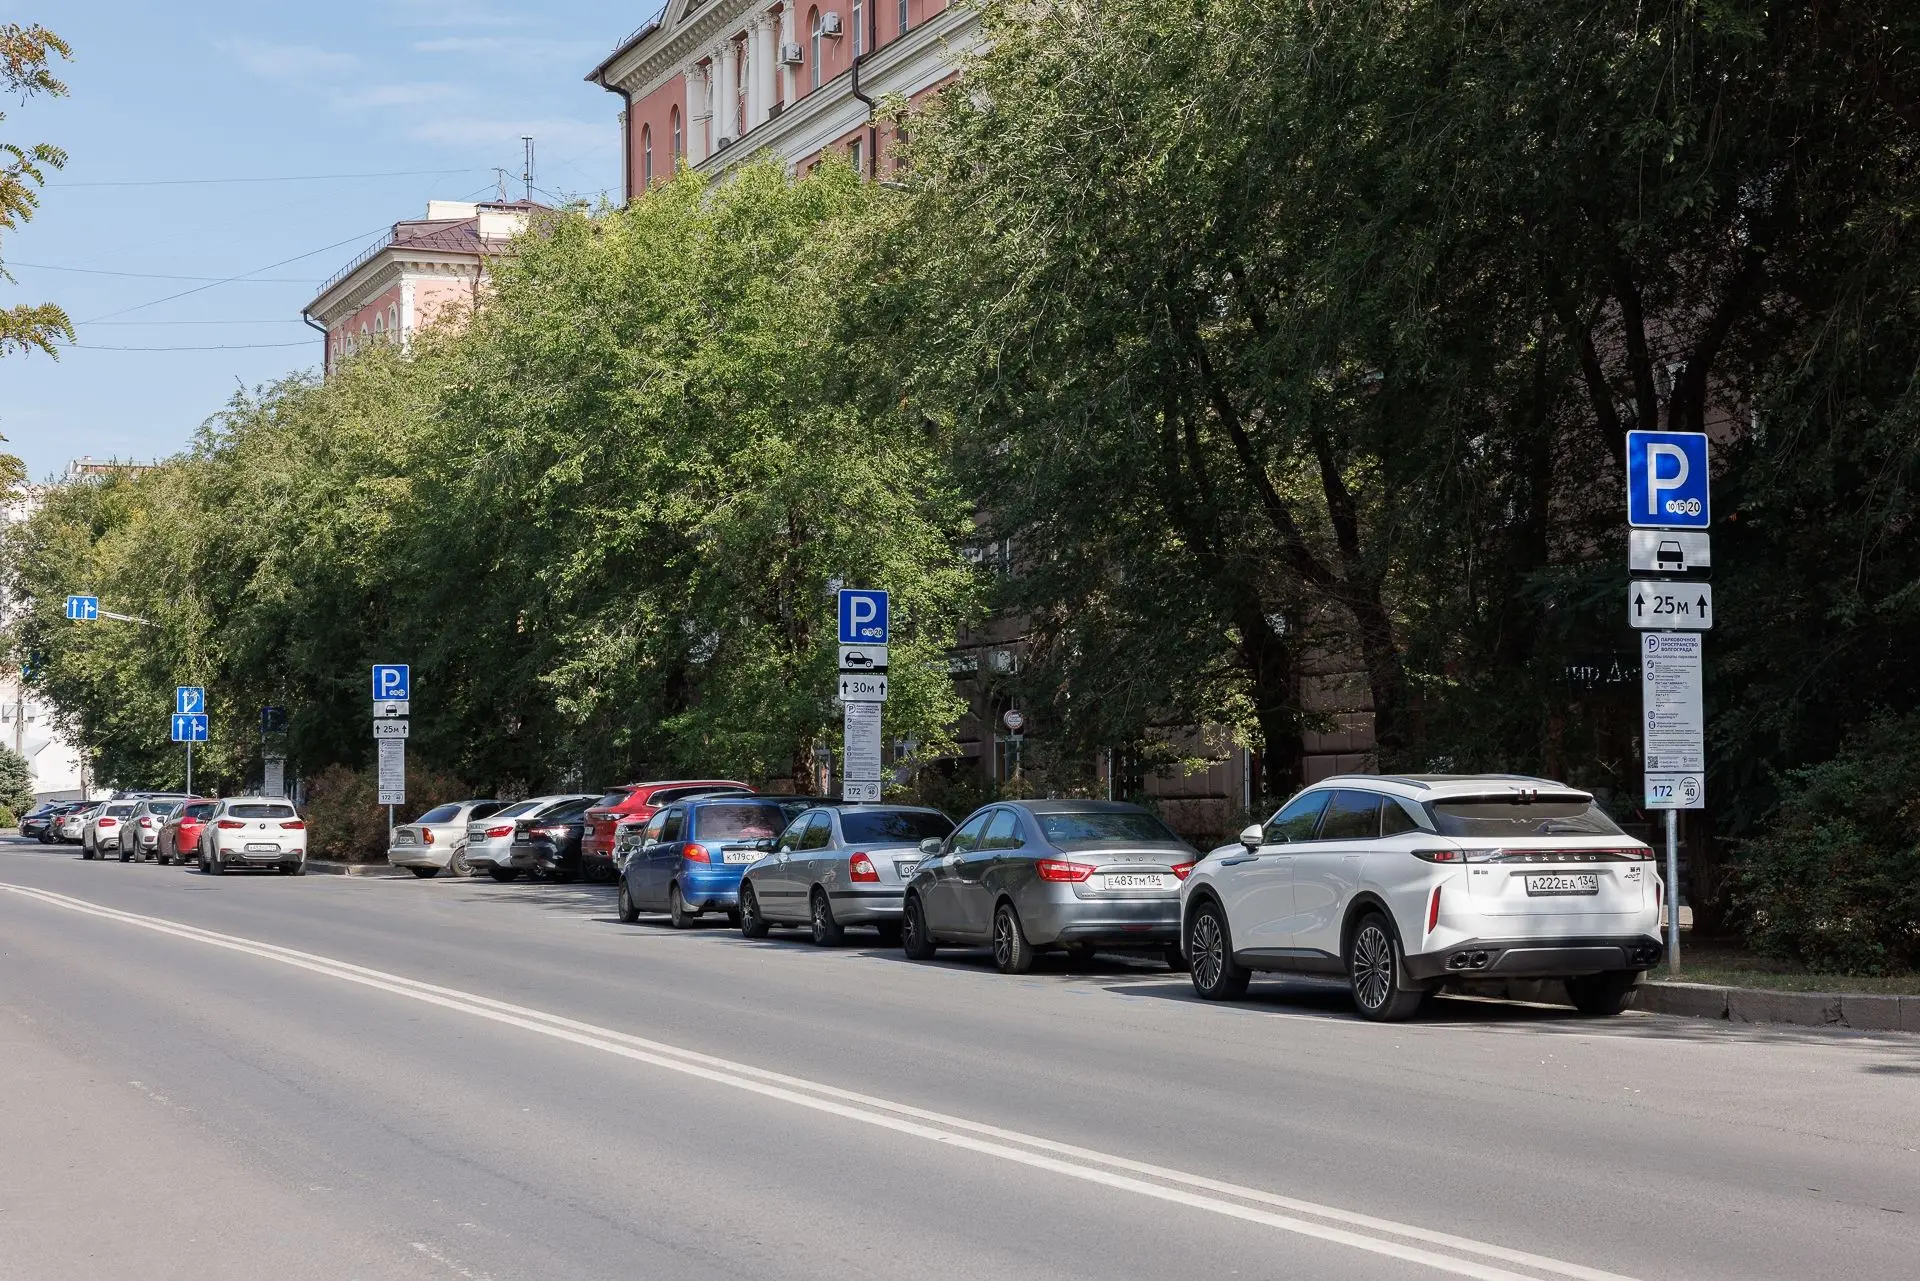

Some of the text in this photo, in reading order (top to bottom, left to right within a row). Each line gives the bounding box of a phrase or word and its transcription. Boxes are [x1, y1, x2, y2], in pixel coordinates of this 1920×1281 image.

[1647, 443, 1689, 515] P
[1677, 503, 1685, 511] 15
[1687, 501, 1700, 512] 20
[1653, 596, 1689, 614] 25м
[850, 596, 877, 637] P
[381, 668, 401, 697] P
[852, 682, 875, 693] 30м
[1652, 785, 1673, 797] 172
[1684, 788, 1695, 796] 40
[1108, 875, 1161, 886] Е483ТМ 134
[1532, 876, 1594, 890] А222ЕА 134
